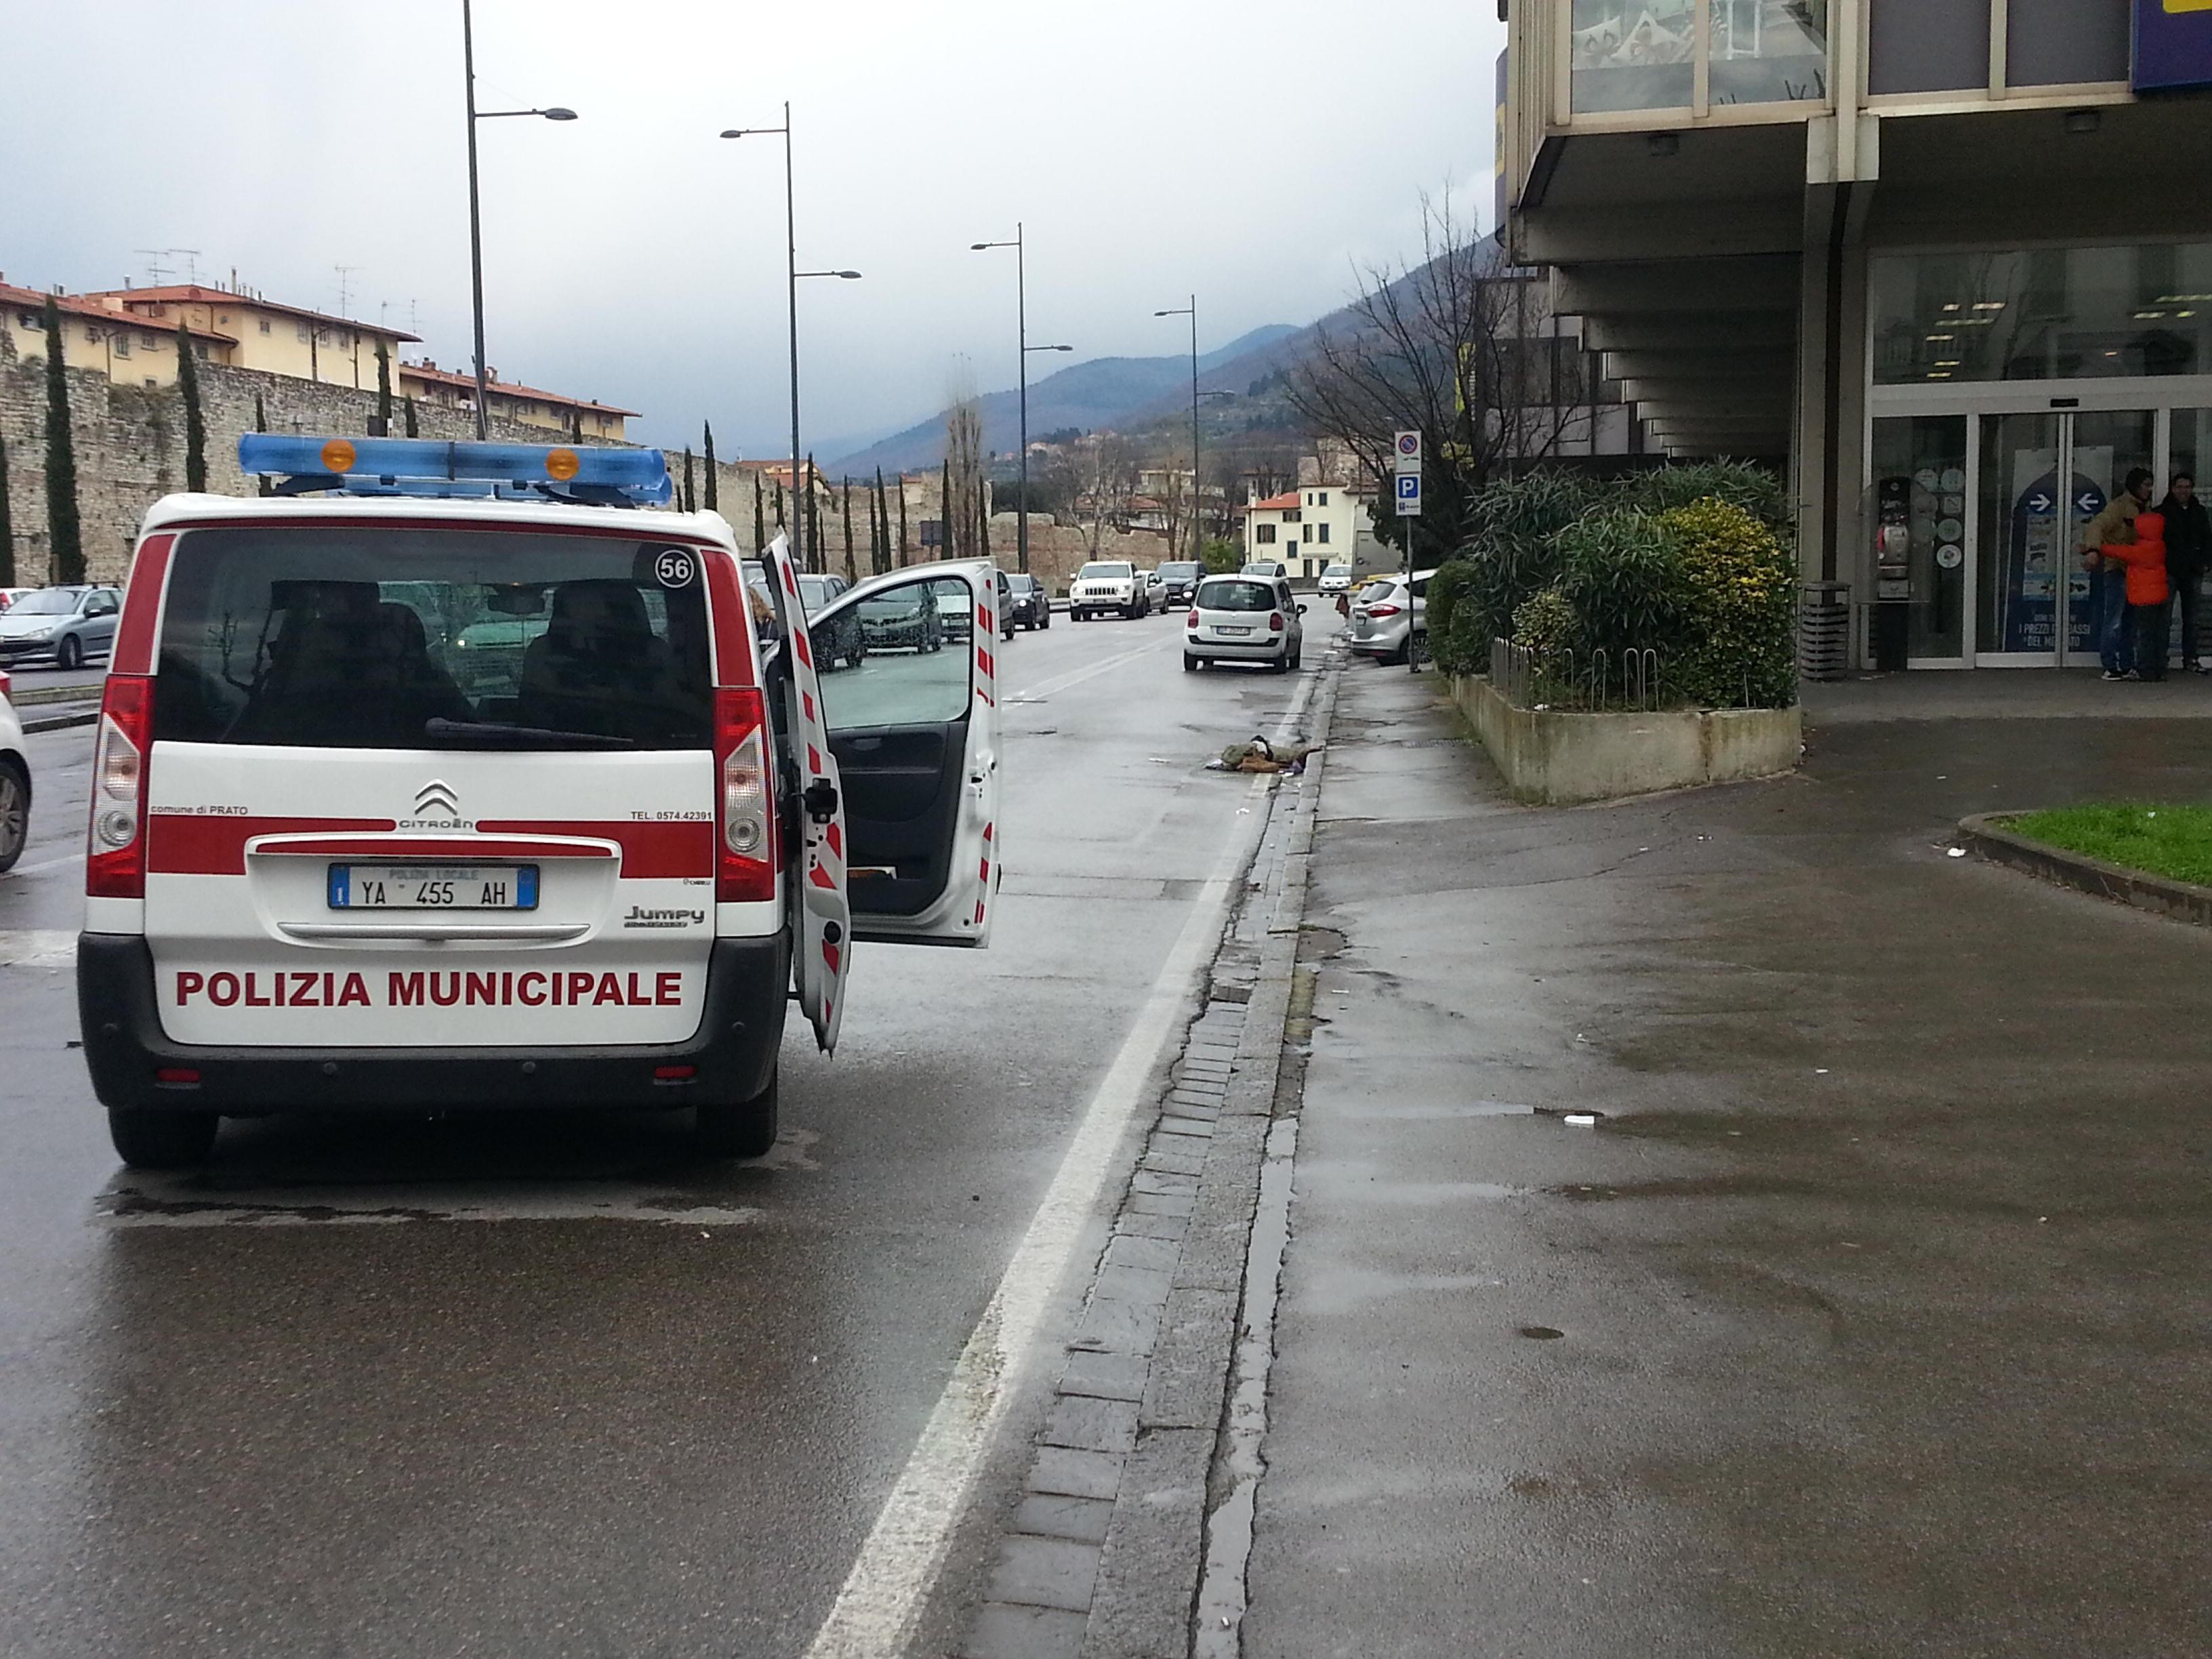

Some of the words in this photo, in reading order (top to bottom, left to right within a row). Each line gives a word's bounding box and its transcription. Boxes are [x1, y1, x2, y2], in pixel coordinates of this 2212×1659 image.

[1402, 479, 1414, 496] P
[660, 558, 689, 579] 56
[2024, 623, 2050, 634] PREZZI
[150, 805, 194, 814] comune
[197, 804, 207, 814] di
[209, 805, 248, 815] PRATO
[630, 811, 654, 820] TEL.
[657, 811, 712, 820] 0574.42391
[362, 881, 386, 904] YA
[416, 882, 454, 905] 455
[480, 882, 506, 905] AH
[623, 905, 705, 924] Jumpy
[176, 971, 372, 1007] POLIZIA
[388, 971, 682, 1007] MUNICIPALE
